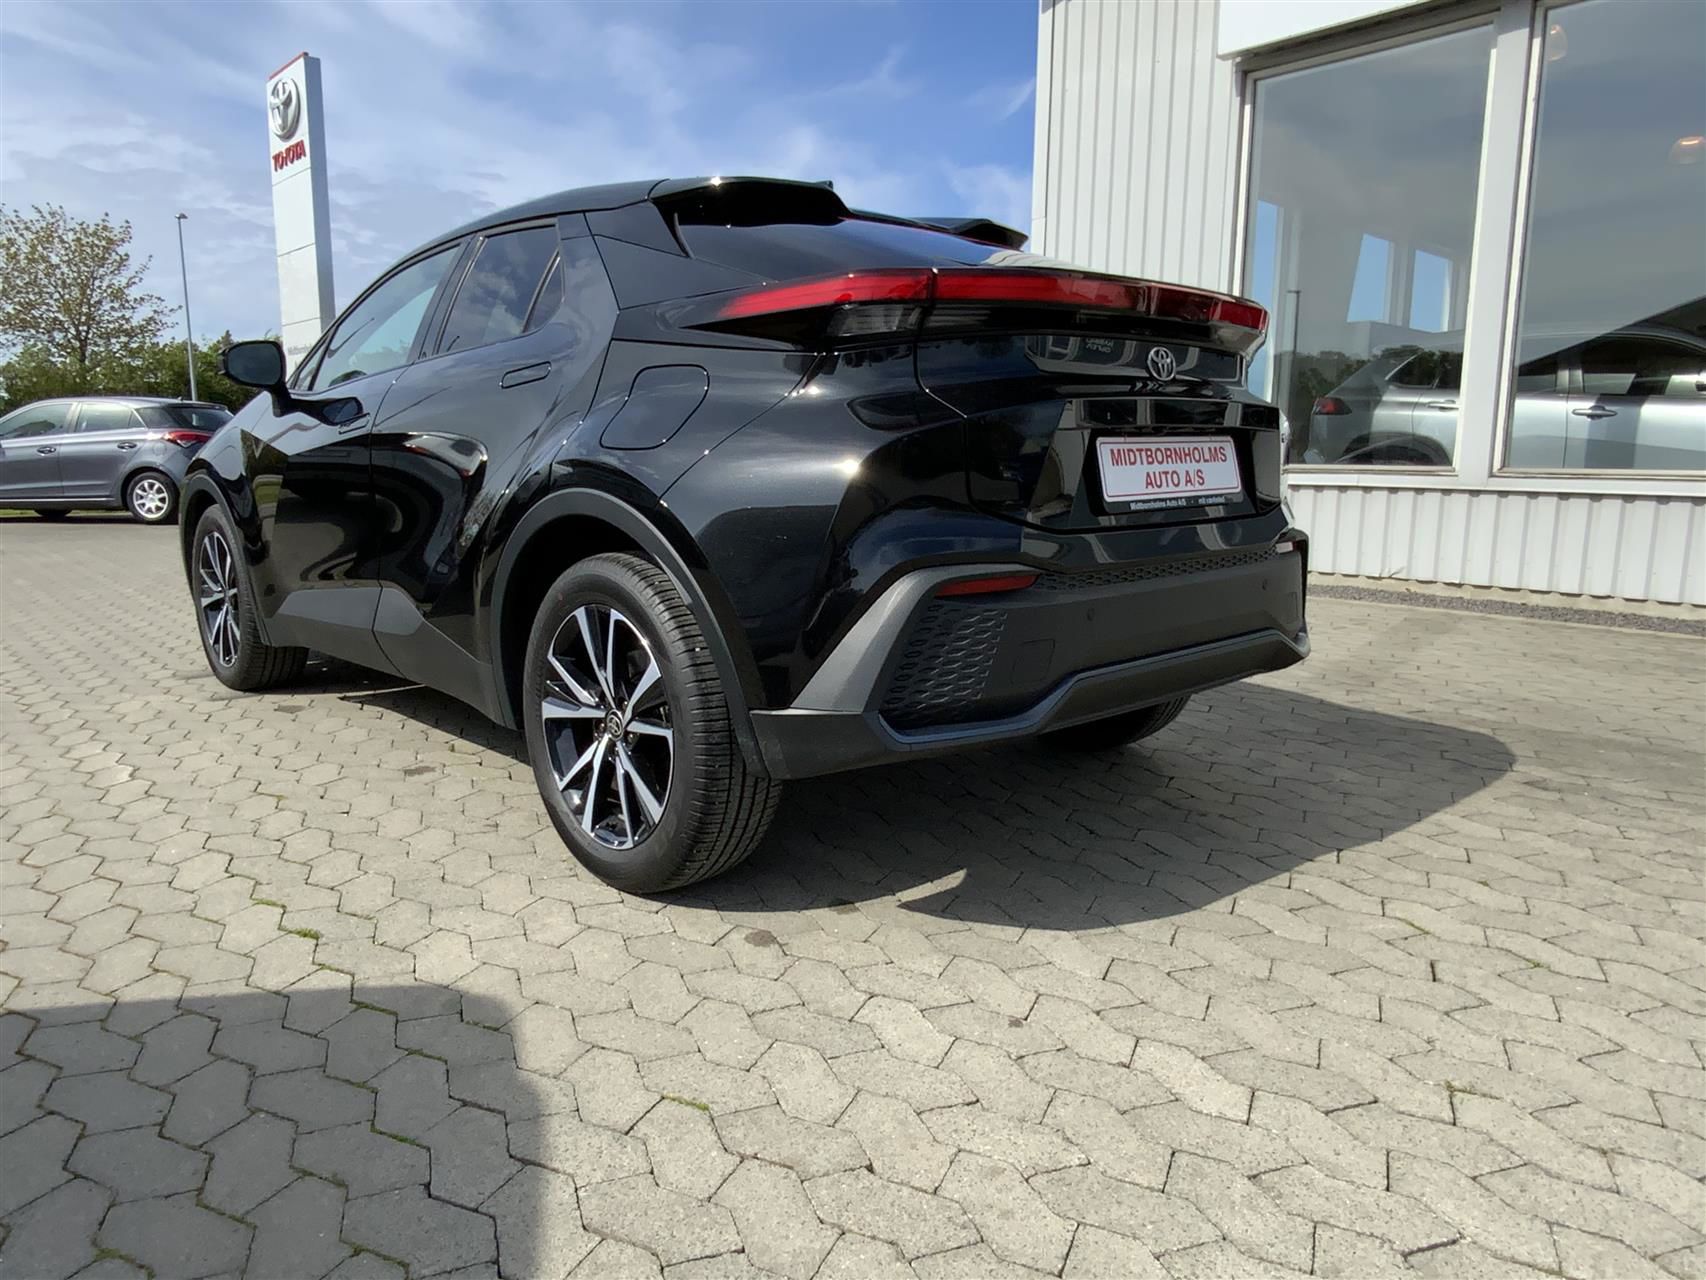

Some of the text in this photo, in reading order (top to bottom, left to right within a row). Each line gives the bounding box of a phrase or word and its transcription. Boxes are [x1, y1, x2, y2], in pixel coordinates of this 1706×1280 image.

[272, 139, 306, 172] TOYOTA
[1110, 446, 1228, 467] MIDTBORNHOLMS
[1145, 468, 1205, 489] AUTO A/S
